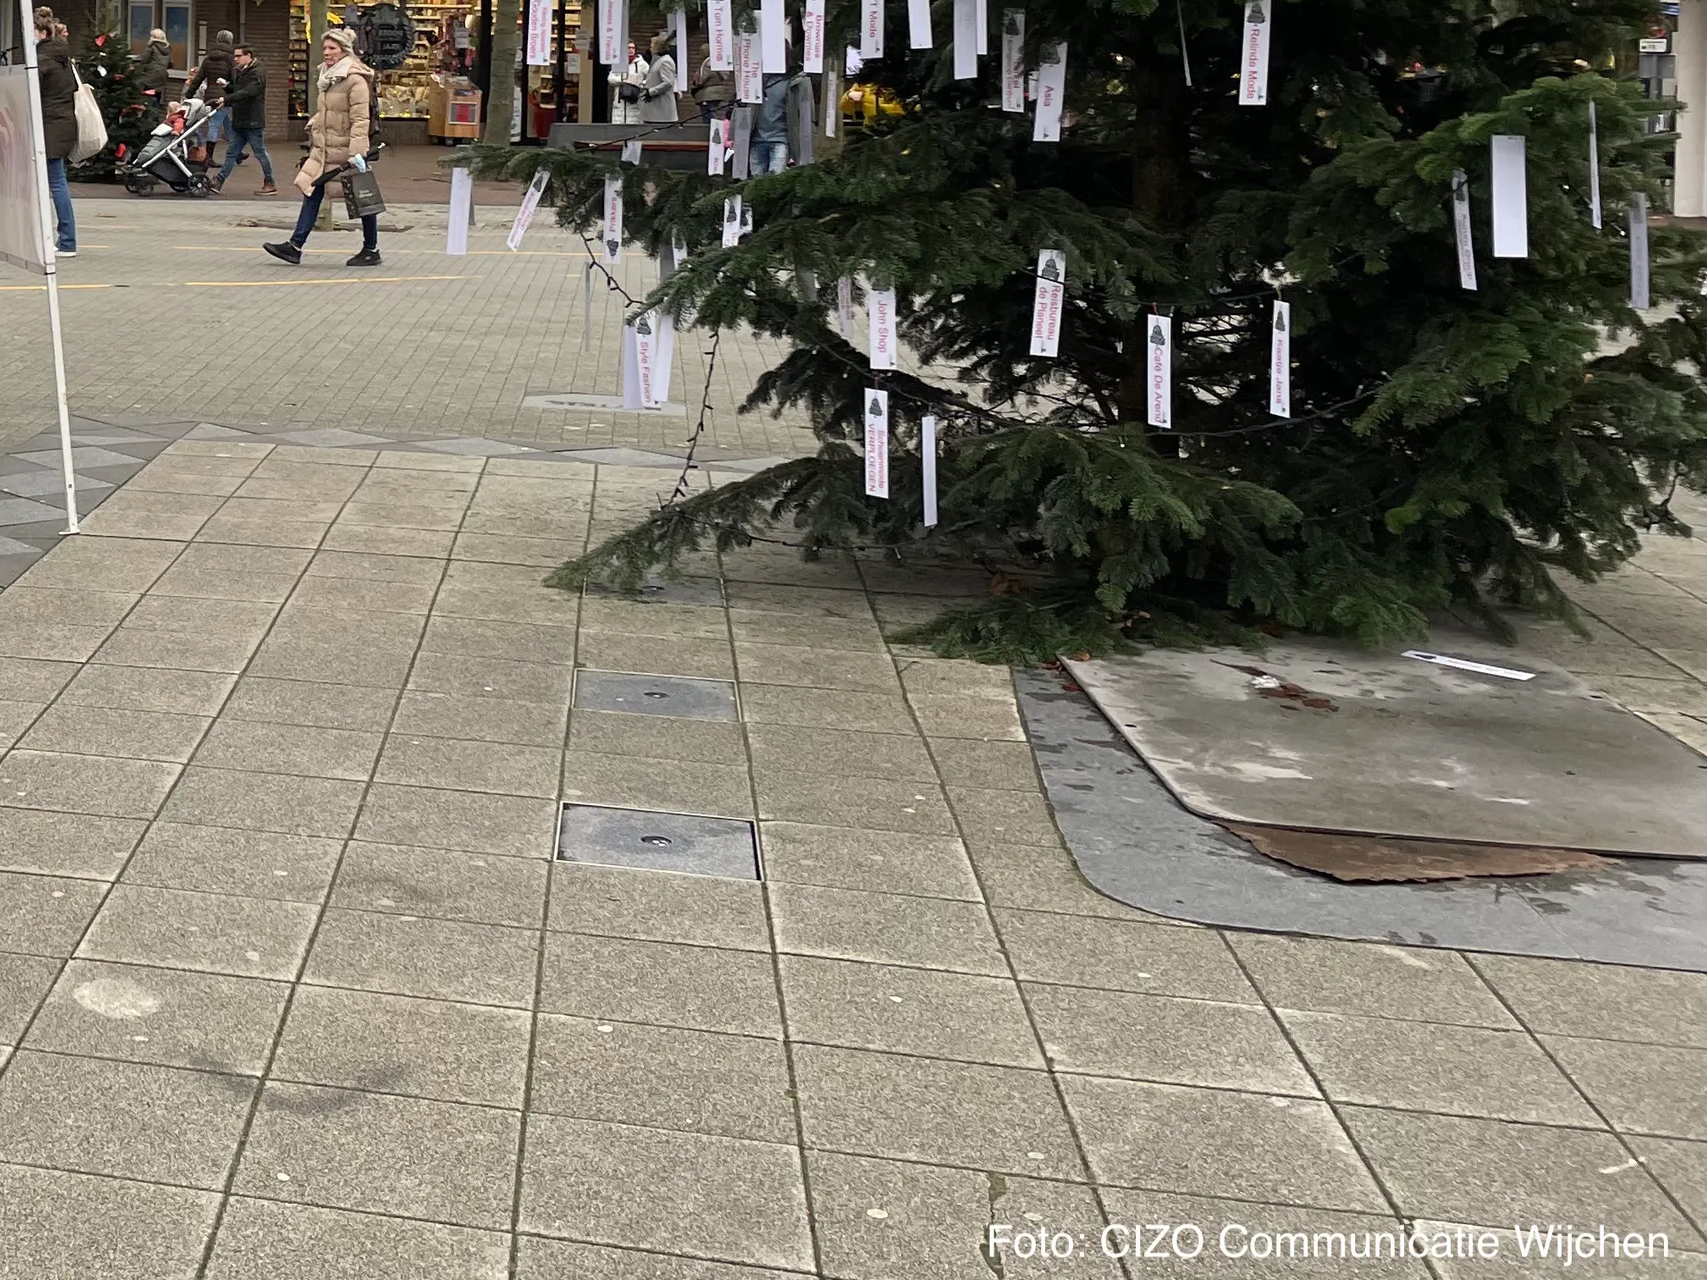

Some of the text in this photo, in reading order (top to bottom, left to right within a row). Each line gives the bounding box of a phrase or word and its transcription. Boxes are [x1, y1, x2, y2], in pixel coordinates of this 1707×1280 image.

[1246, 28, 1260, 99] Relinde Mode
[876, 300, 888, 353] John Shop
[1047, 285, 1061, 341] Reisbureau
[641, 366, 651, 403] Fashion
[1154, 375, 1163, 389] De
